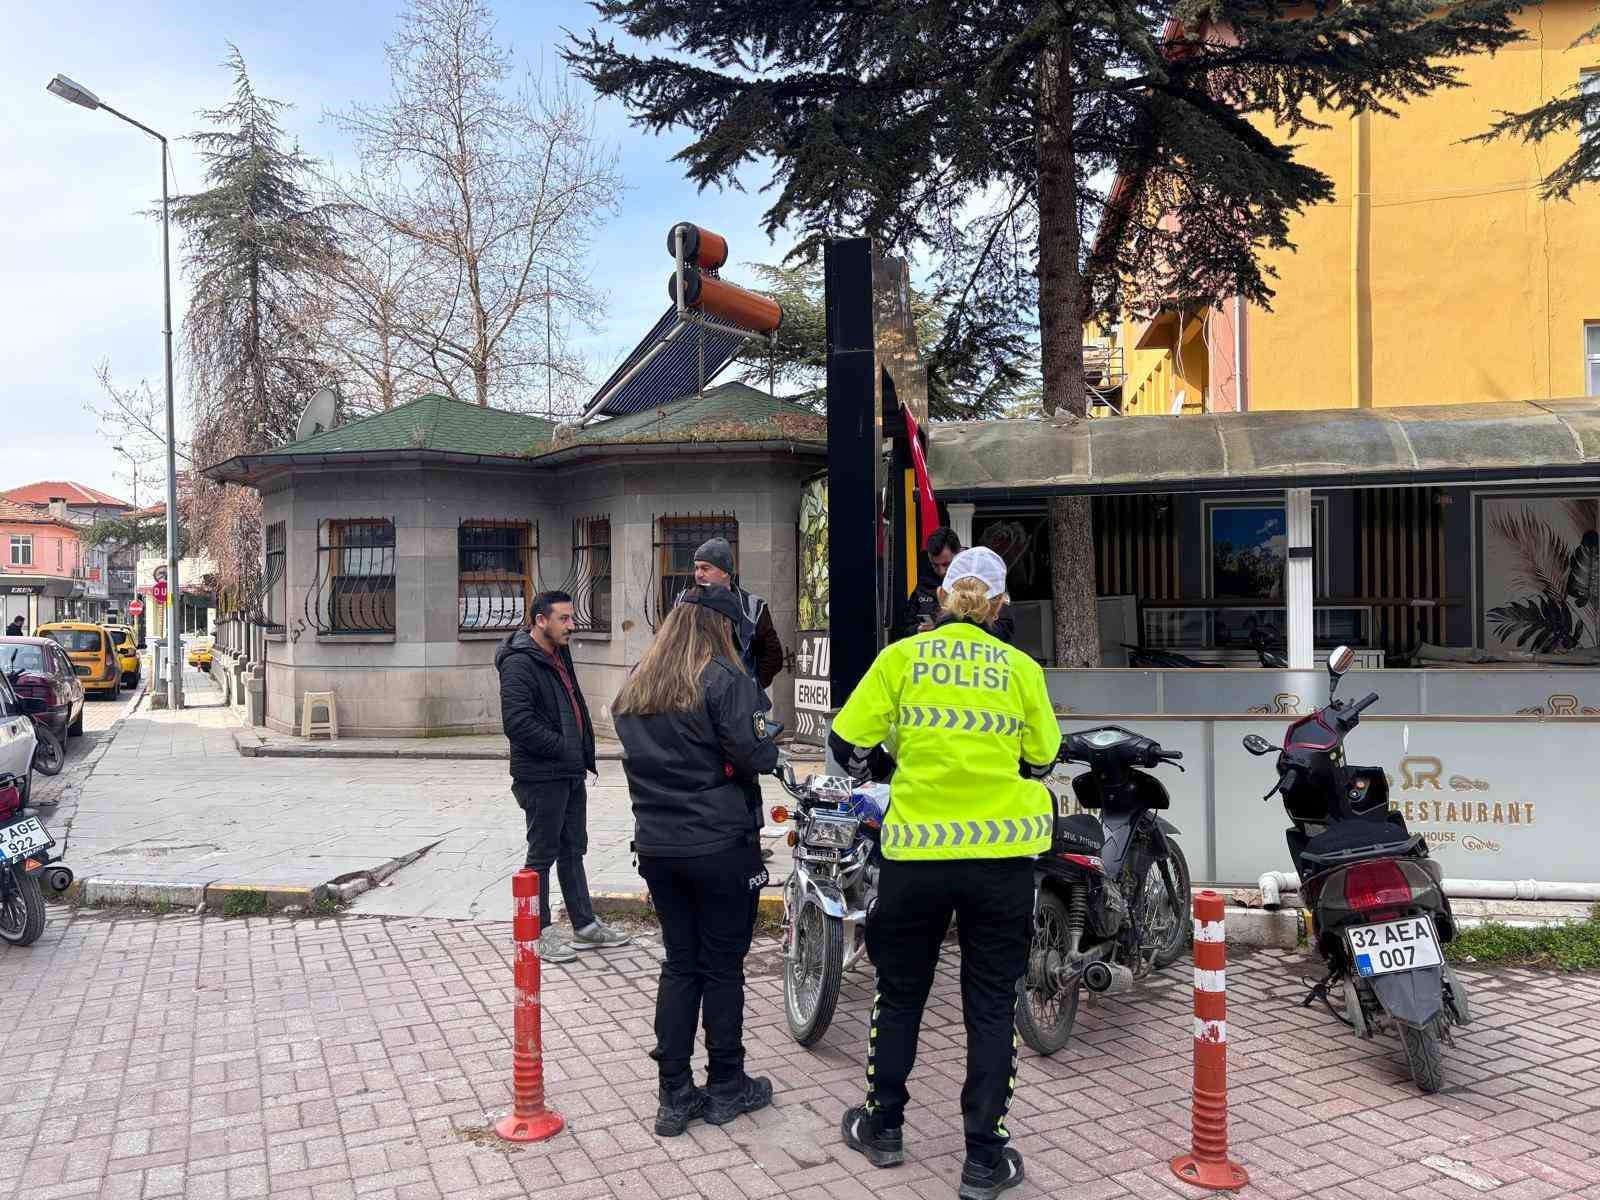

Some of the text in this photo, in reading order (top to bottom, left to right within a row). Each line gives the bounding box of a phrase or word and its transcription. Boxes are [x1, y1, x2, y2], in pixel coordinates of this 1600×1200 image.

[154, 587, 168, 596] DU
[811, 637, 831, 677] TU
[798, 684, 829, 706] ERKEK
[0, 819, 40, 844] 2 AGE
[1423, 832, 1457, 842] HOUSE
[8, 837, 37, 854] 922
[1352, 921, 1429, 948] 32 AEA
[1378, 945, 1415, 969] 007
